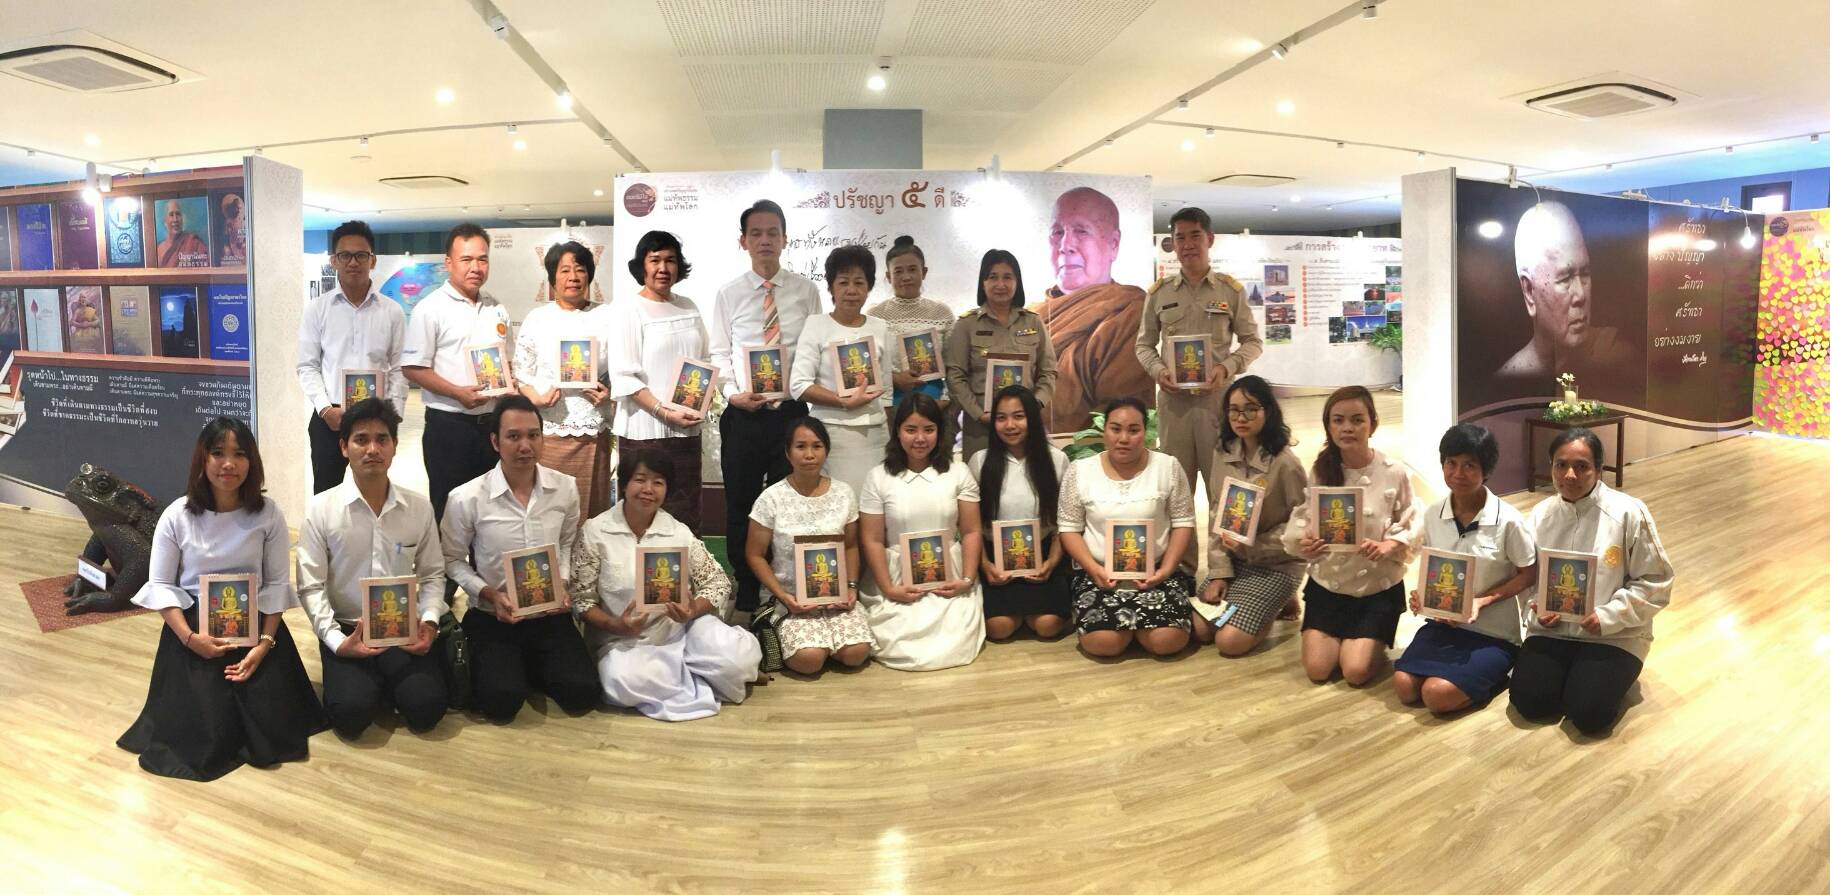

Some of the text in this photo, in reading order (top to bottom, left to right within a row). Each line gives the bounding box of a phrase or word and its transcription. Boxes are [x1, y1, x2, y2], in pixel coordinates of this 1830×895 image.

[833, 181, 945, 214] ปรัชญา ๕ ดี
[1675, 301, 1703, 317] ศรัทธา
[1654, 327, 1702, 348] อย่างงมงาย
